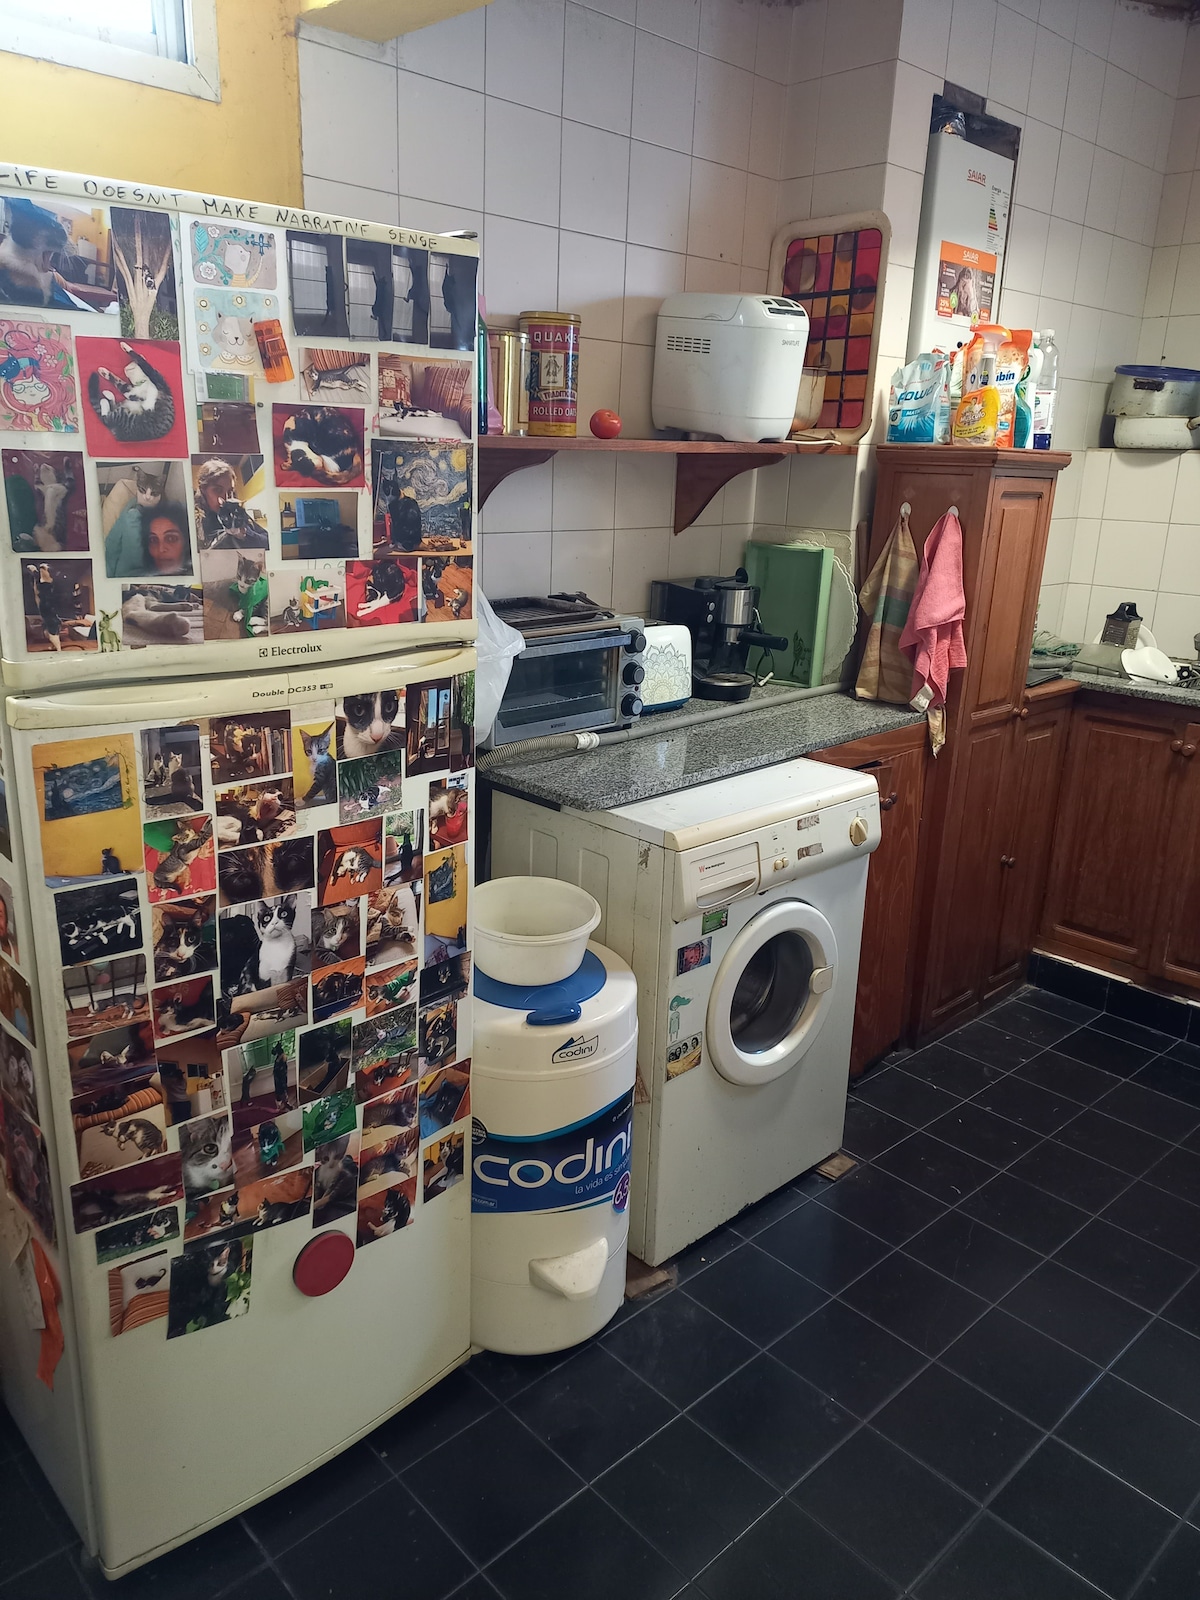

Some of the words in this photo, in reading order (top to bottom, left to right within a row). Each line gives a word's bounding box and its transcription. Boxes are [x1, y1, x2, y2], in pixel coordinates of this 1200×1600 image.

[967, 168, 987, 184] SAIAR
[201, 198, 259, 219] MAKE
[388, 228, 438, 250] SENSE
[963, 245, 980, 261] SAIAR
[532, 406, 564, 417] ROLLED
[271, 643, 323, 657] Electrolux
[252, 688, 285, 698] Double
[287, 684, 317, 695] DC353
[558, 1045, 594, 1059] codini
[575, 1185, 585, 1195] la
[585, 1176, 603, 1191] vida
[603, 1171, 614, 1183] es
